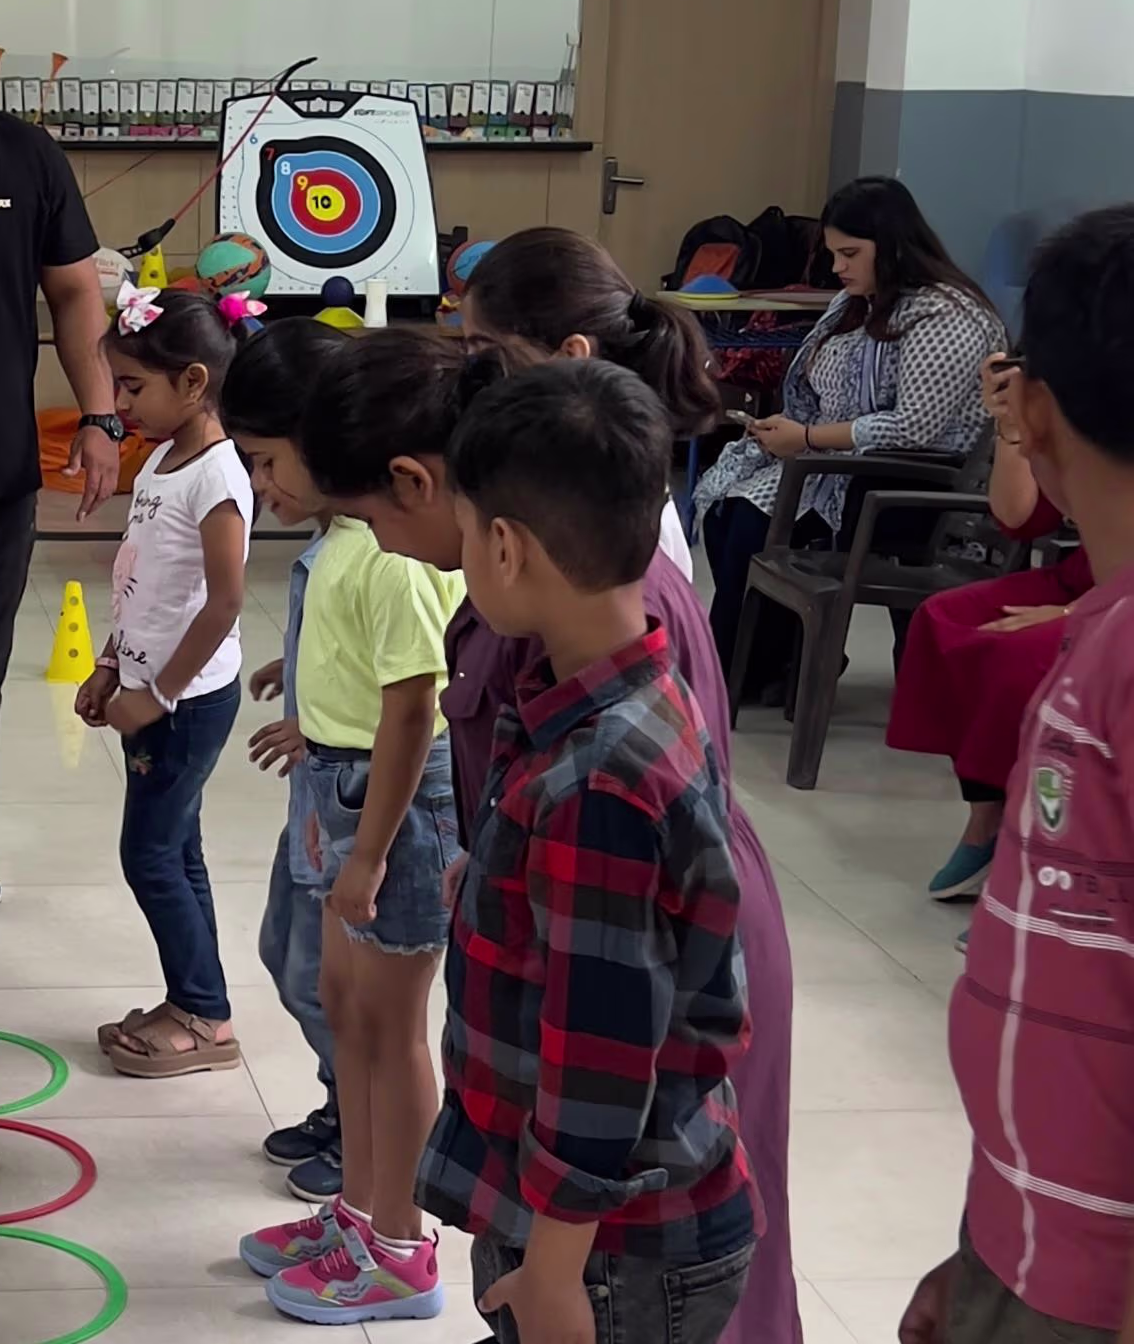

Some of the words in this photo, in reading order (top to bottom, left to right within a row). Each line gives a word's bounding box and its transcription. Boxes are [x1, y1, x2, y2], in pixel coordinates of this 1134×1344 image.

[249, 132, 259, 145] 6
[266, 147, 275, 161] 7
[280, 162, 291, 175] 8
[297, 175, 309, 191] 9
[312, 195, 332, 209] 10
